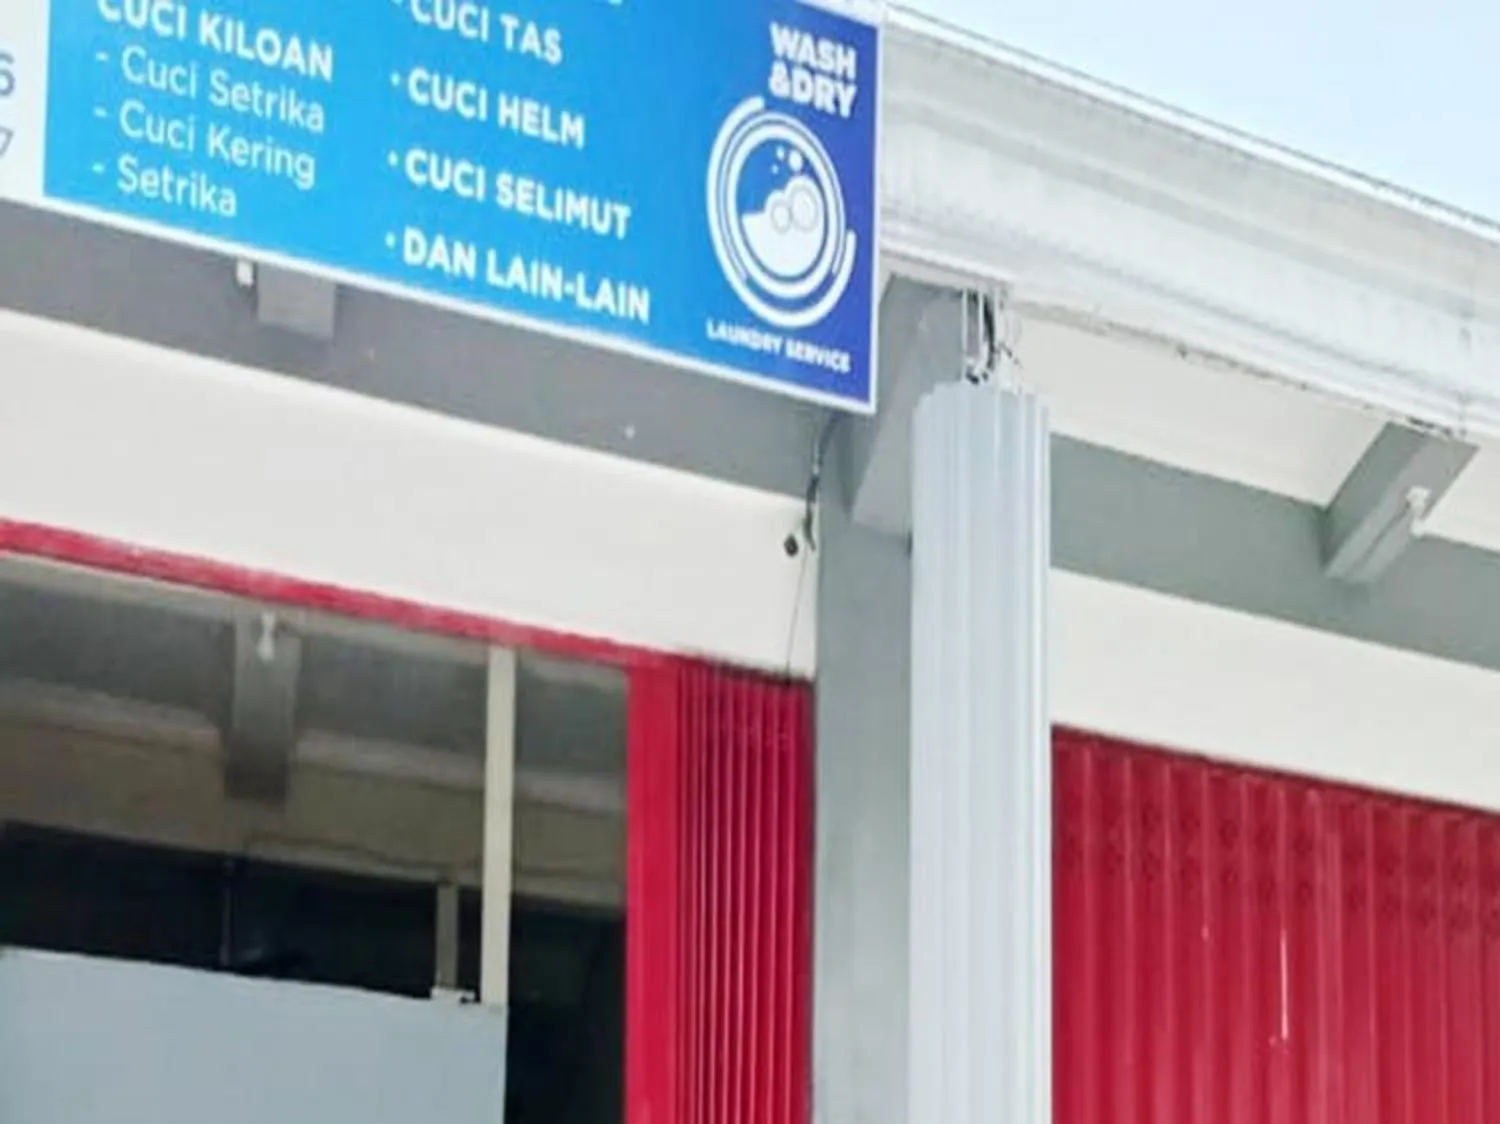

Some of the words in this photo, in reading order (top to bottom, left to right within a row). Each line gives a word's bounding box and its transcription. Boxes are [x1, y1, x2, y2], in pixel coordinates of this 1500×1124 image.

[97, 0, 188, 40] CUCI
[199, 10, 334, 82] KILOAN
[410, 0, 489, 44] CUCI
[500, 13, 563, 65] TAS
[769, 20, 857, 80] WASH
[121, 45, 197, 98] Cuci
[209, 68, 325, 133] Setrika
[408, 66, 488, 122] CUCI
[498, 92, 585, 150] HELM
[117, 153, 238, 217] Setrika
[119, 99, 196, 153] Cuci
[207, 122, 316, 191] Kering
[405, 148, 486, 201] CUCI
[496, 170, 632, 240] SELIMUT
[403, 225, 477, 280] DAN
[487, 248, 650, 326] LAIN-LAIN
[705, 316, 782, 355] LAUNDRY
[784, 337, 851, 374] SERVICE
